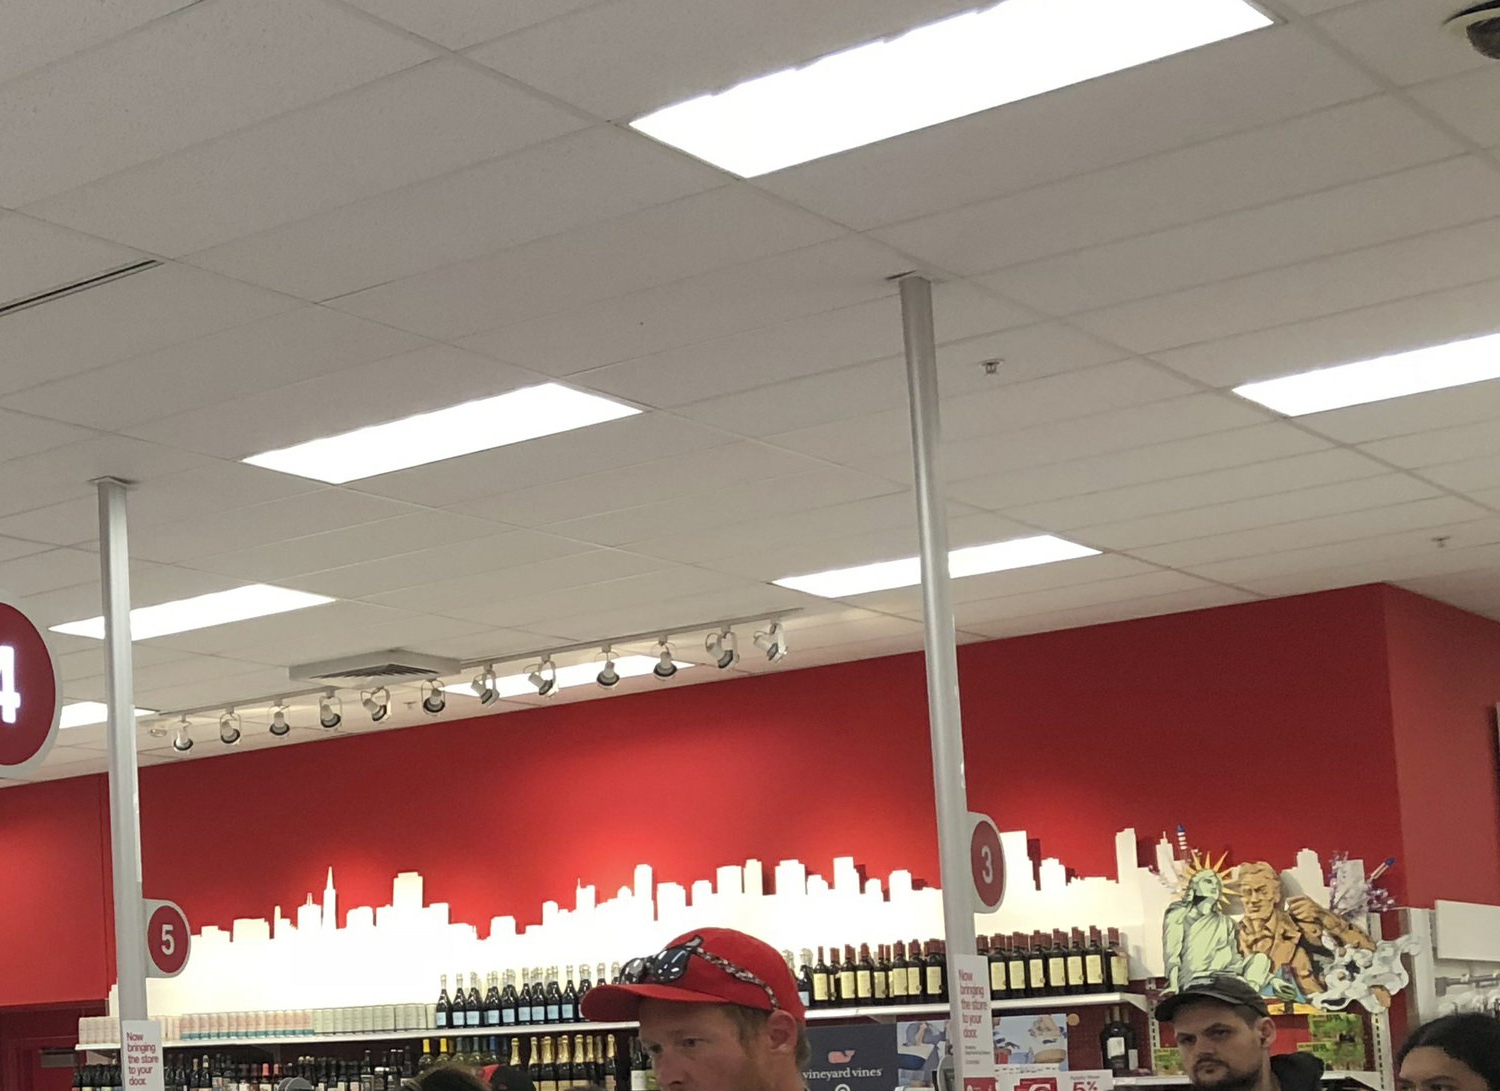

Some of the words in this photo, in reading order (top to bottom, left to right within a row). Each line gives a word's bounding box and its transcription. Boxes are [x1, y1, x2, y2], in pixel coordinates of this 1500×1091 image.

[981, 845, 993, 884] 3
[161, 924, 175, 955] 5
[126, 1032, 143, 1041] Now
[127, 1044, 156, 1054] bringing
[128, 1055, 140, 1063] the
[141, 1055, 159, 1063] store
[129, 1066, 136, 1074] to
[137, 1066, 153, 1076] your
[802, 1067, 850, 1081] vineyard
[850, 1068, 882, 1077] vines
